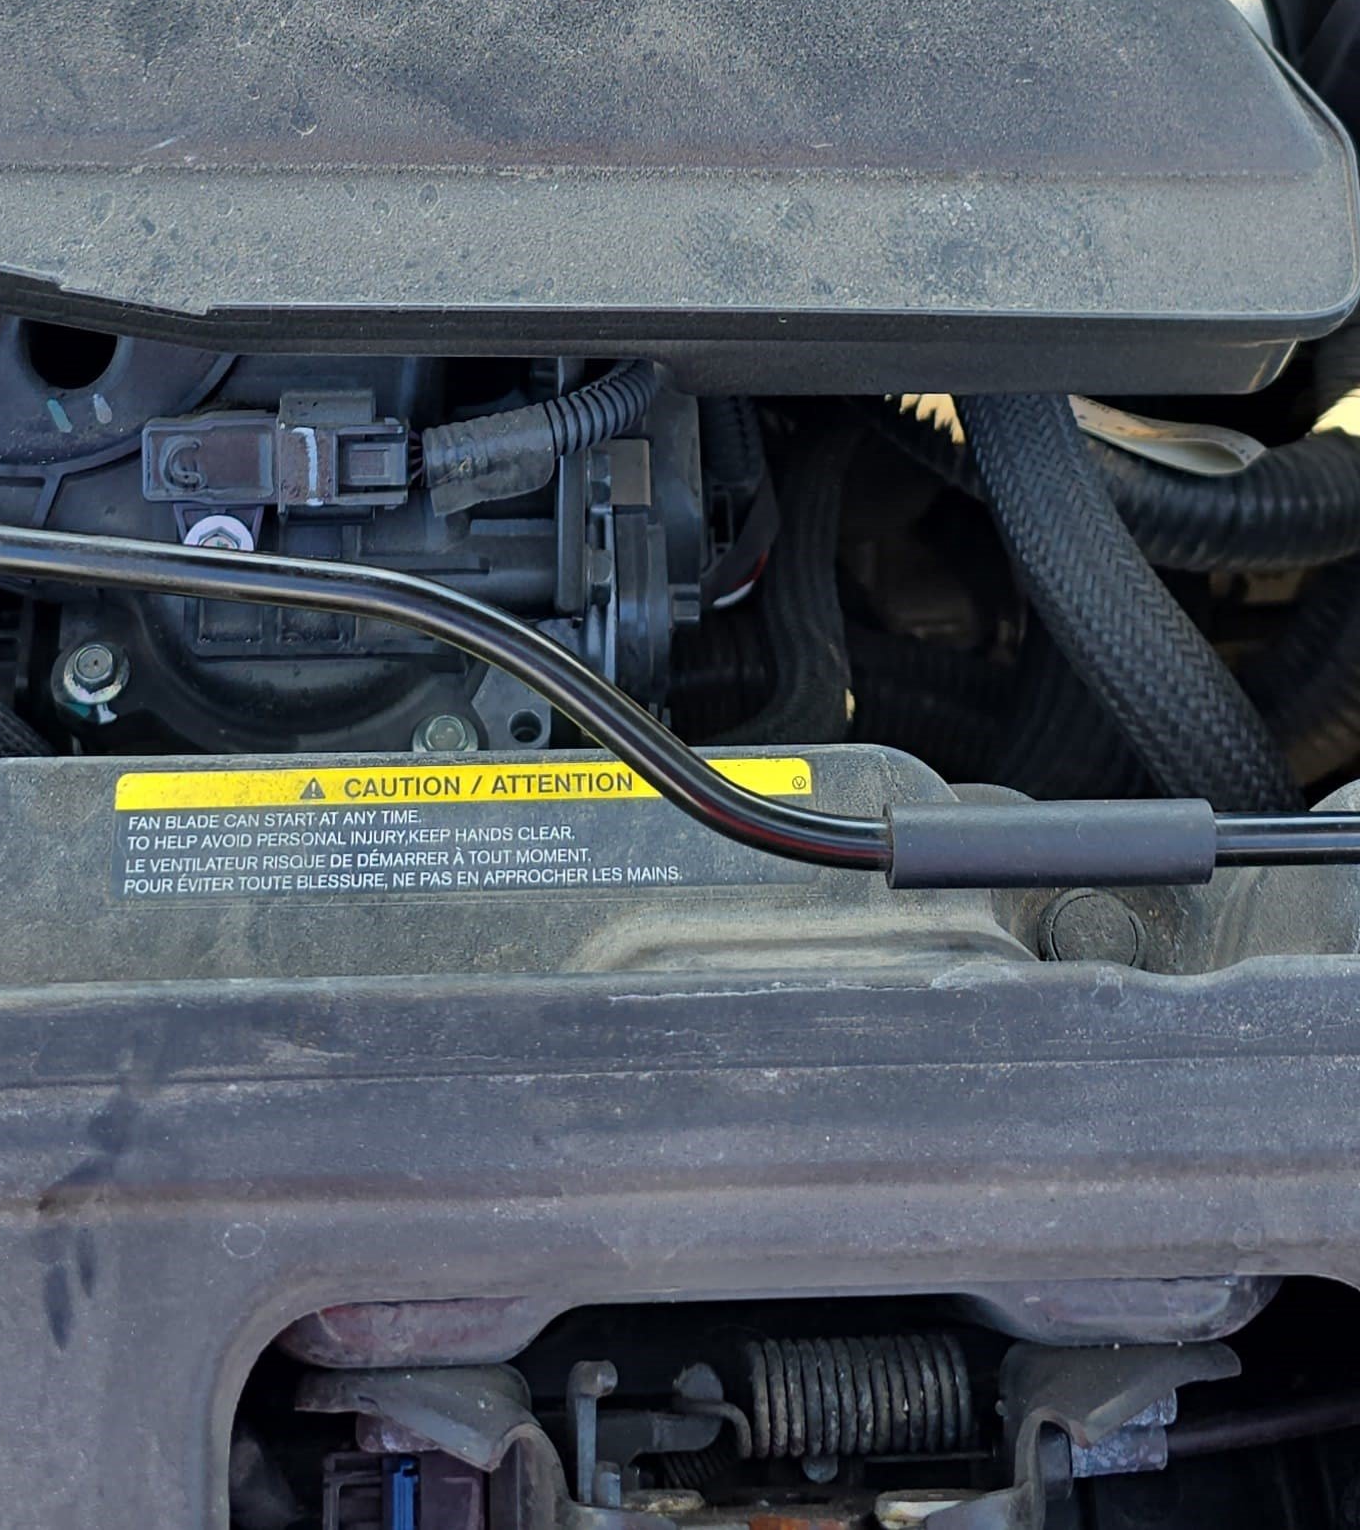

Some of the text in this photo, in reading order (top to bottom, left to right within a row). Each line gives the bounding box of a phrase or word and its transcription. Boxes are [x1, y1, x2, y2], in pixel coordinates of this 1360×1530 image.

[343, 775, 461, 799] CAUTION
[470, 774, 482, 795] /
[491, 772, 634, 795] ATTENTION
[128, 809, 422, 831] FAN BLADE CAN START AT ANY TIME.
[127, 836, 150, 851] TO
[154, 835, 198, 850] HELP
[201, 833, 252, 848] AVOID
[257, 831, 346, 847] PERSONAL
[455, 827, 513, 842] HANDS
[518, 826, 575, 841] CLEAR.
[125, 847, 591, 874] LE VENTILATEUR RISQUE DE DÉMARRER À TOUT MOMENT.
[123, 865, 683, 895] POUR ÉVITER TOUTE BLESSURE, NE PAS EN APPROCHER LES MAINS.
